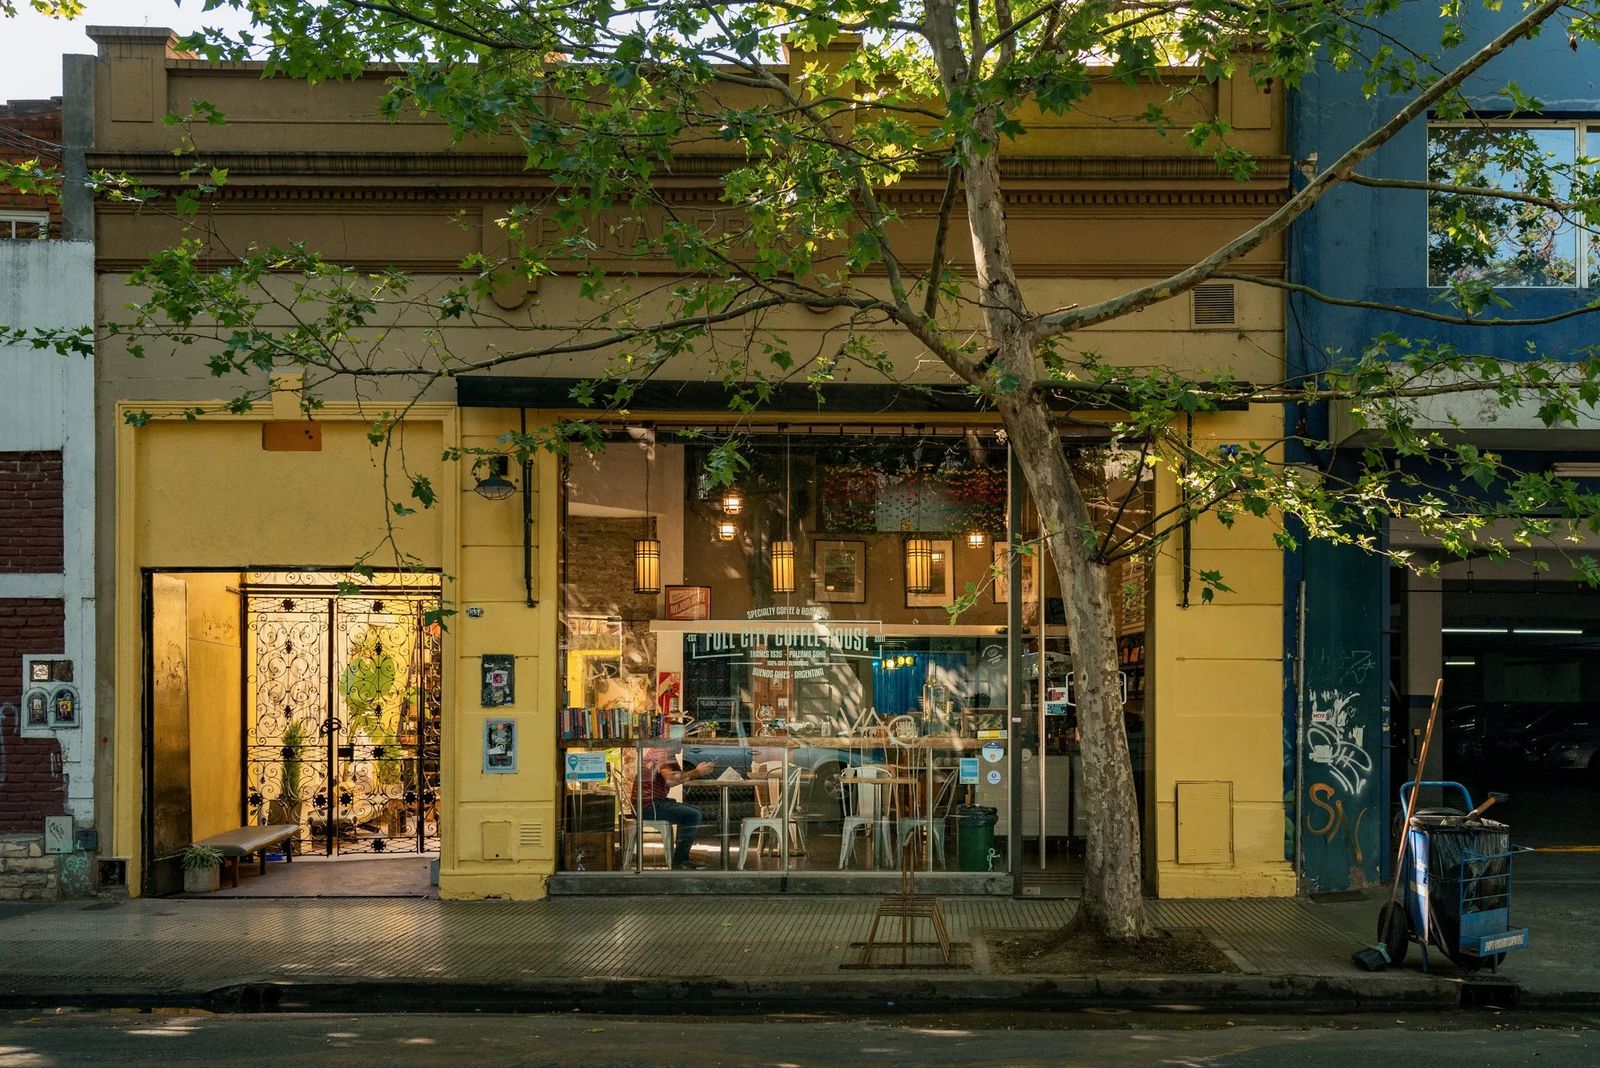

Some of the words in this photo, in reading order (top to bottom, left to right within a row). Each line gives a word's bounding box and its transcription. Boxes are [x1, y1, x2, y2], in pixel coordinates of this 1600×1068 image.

[746, 606, 776, 619] SPECIALTY
[740, 627, 769, 648] CITY
[774, 626, 821, 647] COFFEE
[825, 627, 869, 651] HOUSE
[752, 667, 774, 678] BUENOS
[774, 670, 790, 679] AIRES
[794, 667, 824, 678] ARGENTINA
